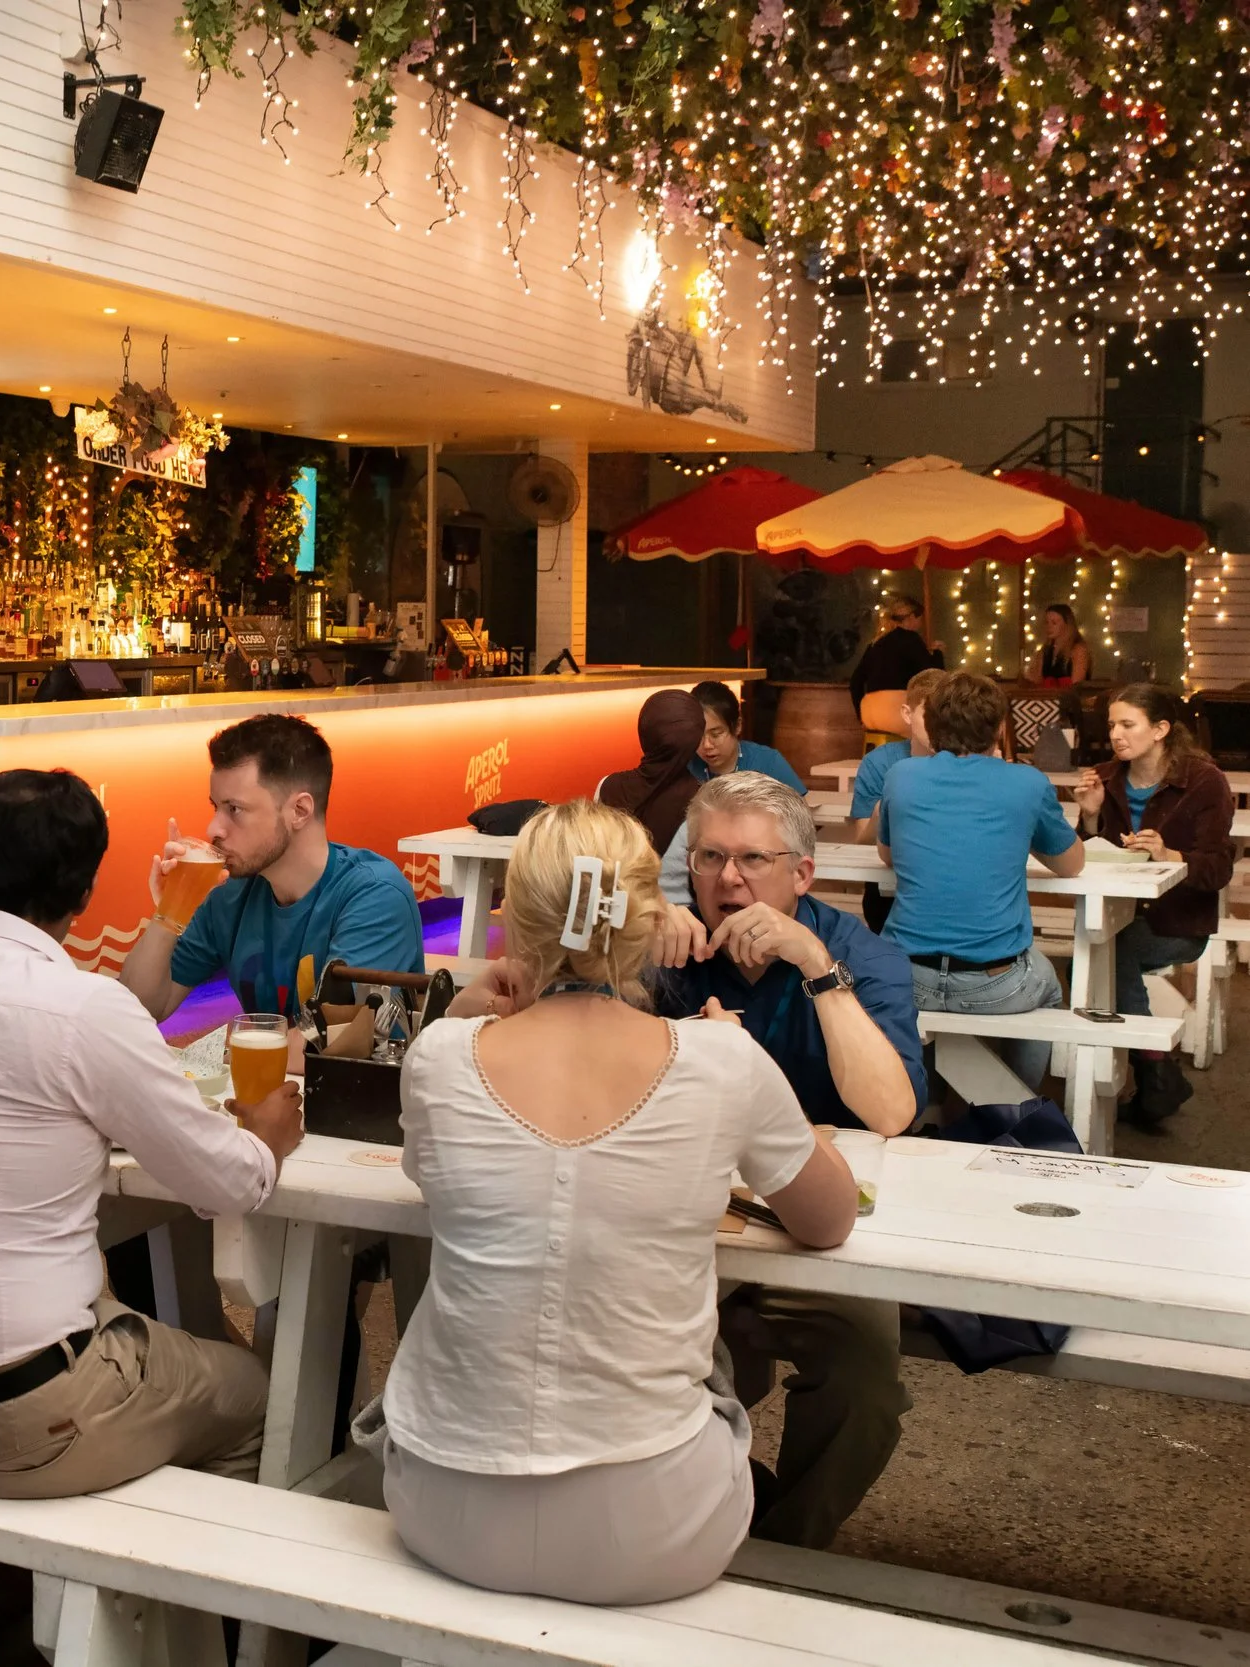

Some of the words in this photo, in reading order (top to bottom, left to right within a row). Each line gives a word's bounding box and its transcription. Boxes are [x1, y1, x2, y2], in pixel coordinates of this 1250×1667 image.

[765, 528, 803, 542] APEROL
[637, 536, 672, 549] APEROL
[237, 634, 266, 644] CLOSED
[464, 737, 510, 794] APEROL
[474, 772, 502, 809] SPRITZ
